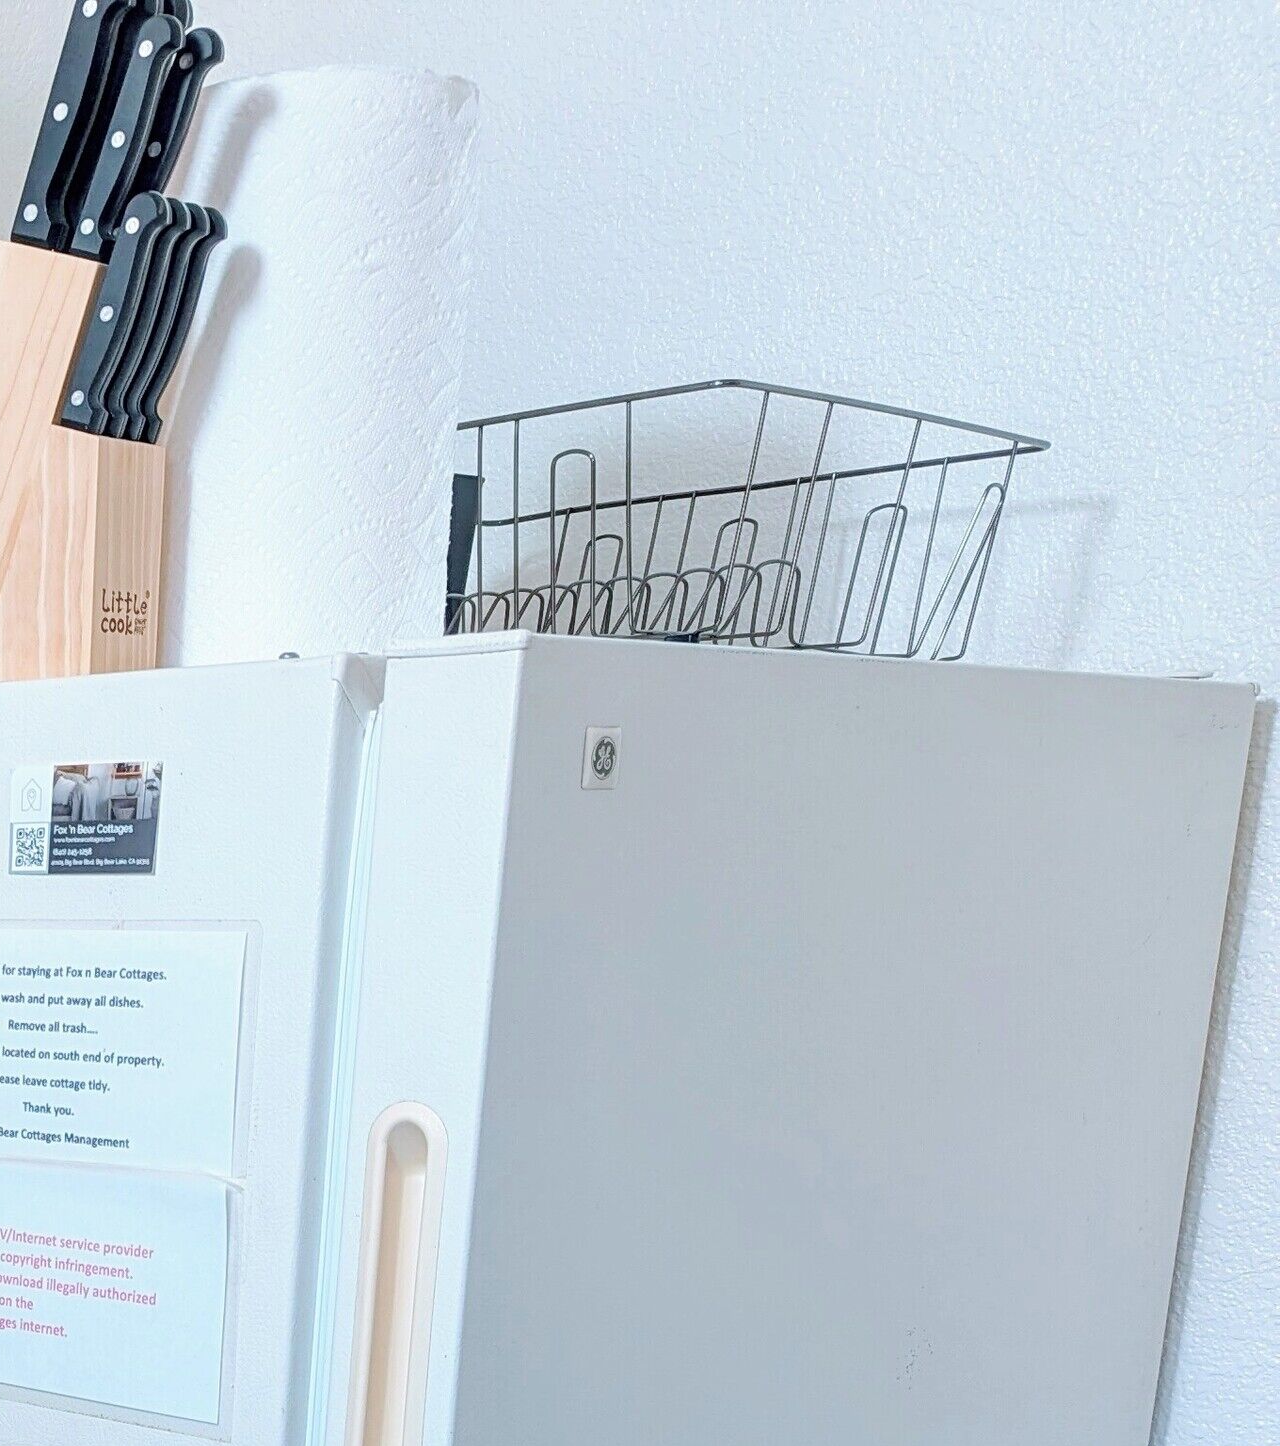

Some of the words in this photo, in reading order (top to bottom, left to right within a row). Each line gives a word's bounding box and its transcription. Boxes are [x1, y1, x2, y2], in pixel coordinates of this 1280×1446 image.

[54, 825, 67, 834] Fox
[77, 824, 95, 834] Bear
[97, 824, 133, 835] Cottages
[1, 964, 15, 976] for
[17, 966, 51, 979] staying
[53, 967, 63, 977] at
[66, 966, 83, 978] Fox
[85, 970, 91, 978] n
[94, 968, 117, 979] Bear
[119, 968, 167, 982] Cottages.
[1, 992, 25, 1004] wash
[27, 993, 45, 1005] and
[48, 994, 64, 1006] put
[66, 997, 92, 1008] away
[94, 995, 107, 1008] all
[109, 997, 144, 1008] dishes.
[8, 1020, 46, 1032] Remove
[48, 1022, 60, 1033] all
[2, 1046, 36, 1059] located
[38, 1051, 50, 1060] on
[53, 1049, 80, 1061] south
[82, 1051, 101, 1063] end
[104, 1051, 115, 1063] of
[117, 1053, 164, 1068] property.
[22, 1074, 47, 1087] leave
[50, 1076, 86, 1091] cottage
[88, 1079, 110, 1093] tidy.
[23, 1101, 51, 1114] Thank
[53, 1105, 74, 1118] you.
[21, 1128, 62, 1143] Cottages
[64, 1132, 130, 1148] Management
[59, 1238, 100, 1253] service
[103, 1241, 154, 1260] provider
[0, 1251, 52, 1268] copyright
[54, 1257, 133, 1280] infringement.
[46, 1278, 90, 1298] illegally
[92, 1285, 157, 1306] authorized
[15, 1296, 33, 1310] the
[19, 1318, 68, 1337] internet.
